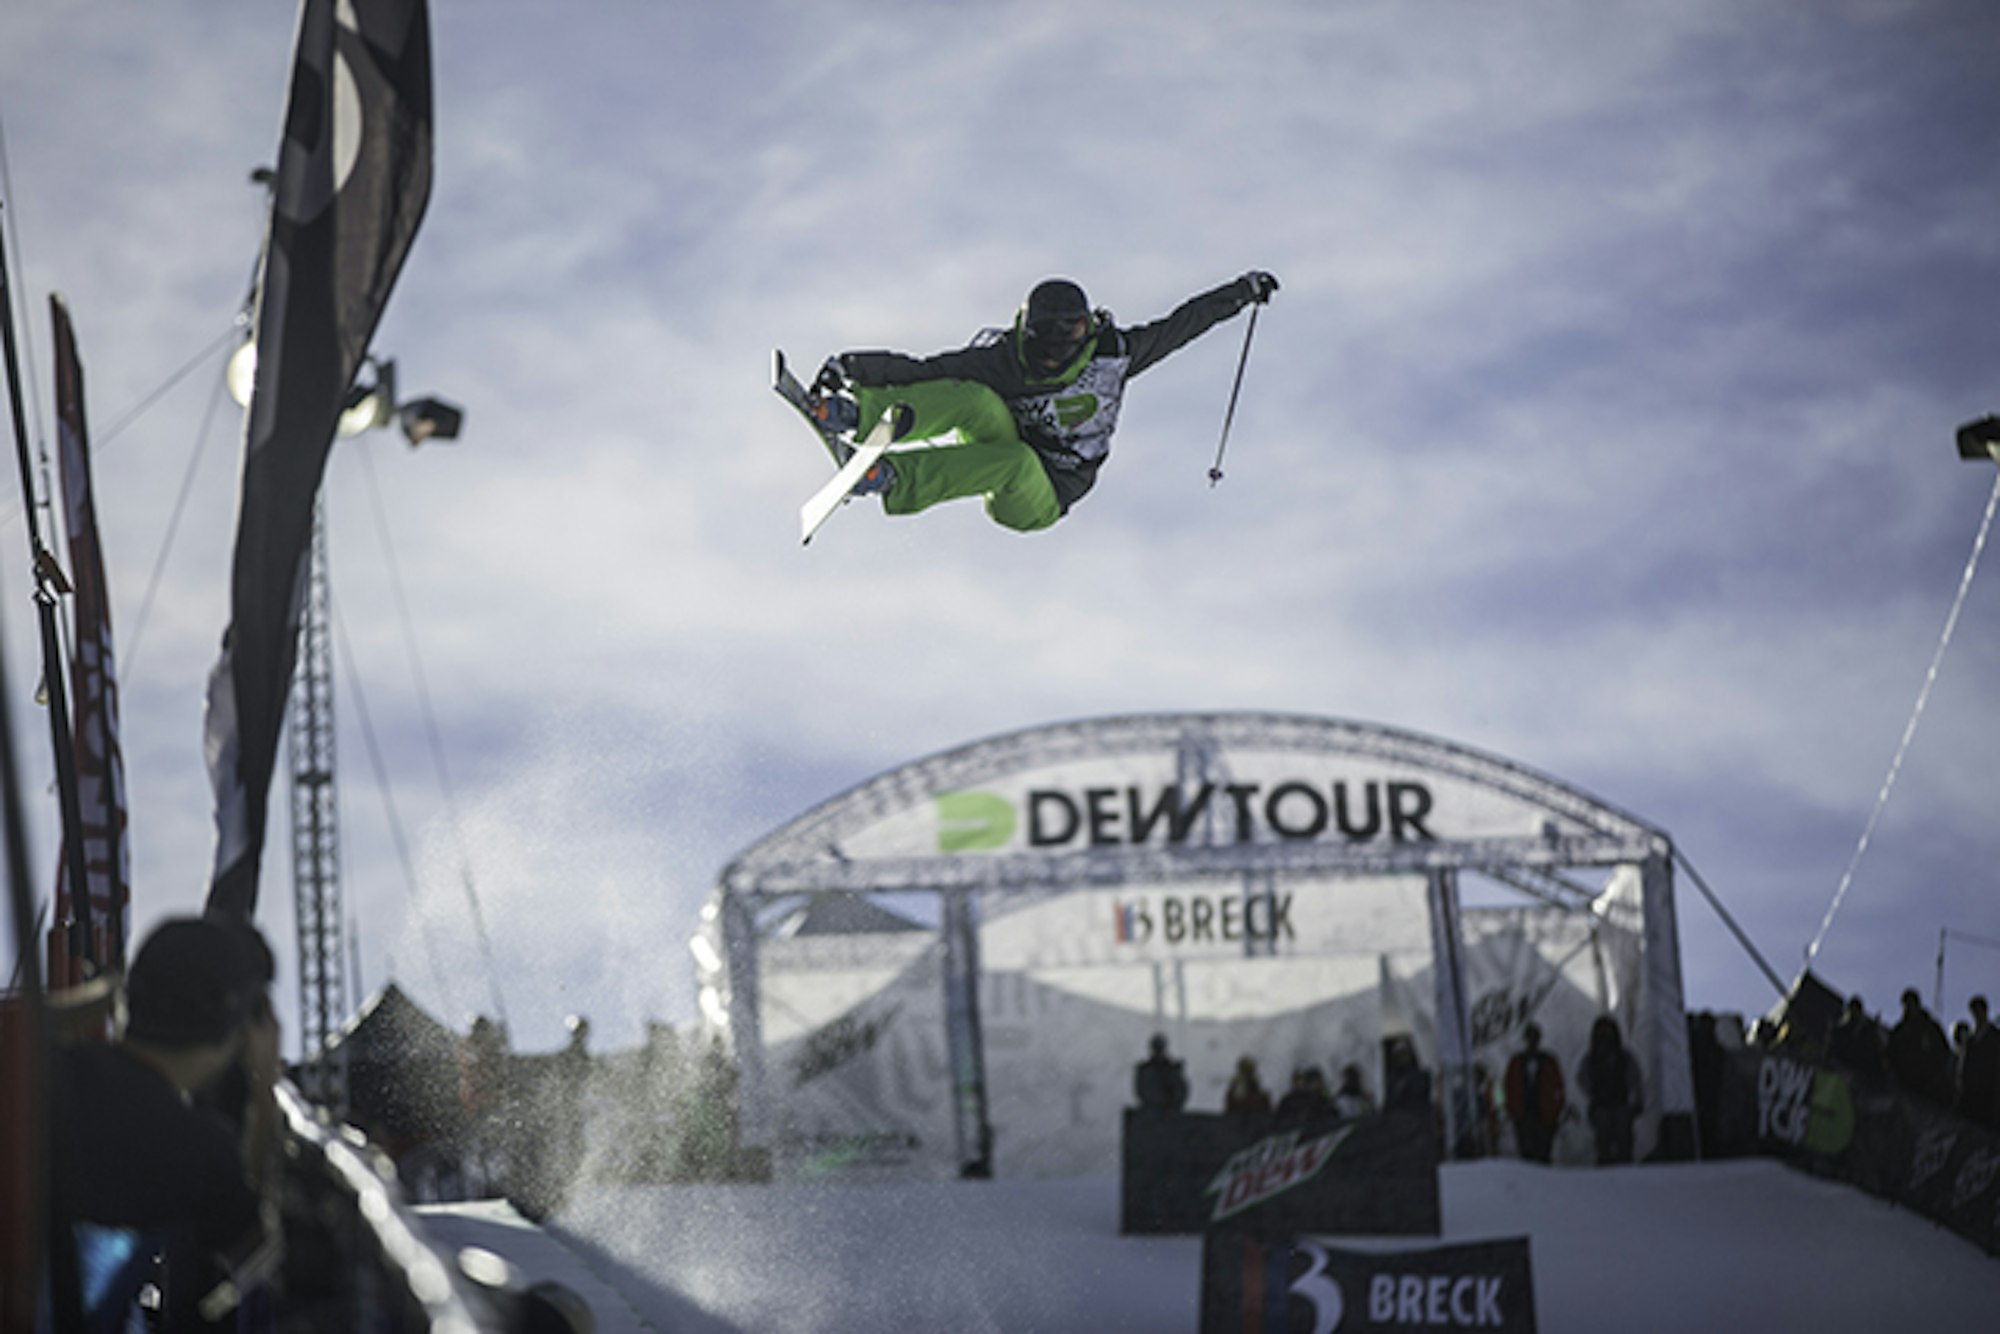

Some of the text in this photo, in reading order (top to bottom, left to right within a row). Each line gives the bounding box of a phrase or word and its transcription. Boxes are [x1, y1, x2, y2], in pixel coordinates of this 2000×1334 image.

[1027, 780, 1437, 847] DEW TOUR
[1164, 894, 1296, 943] BRECK
[1368, 1273, 1503, 1326] BRECK
